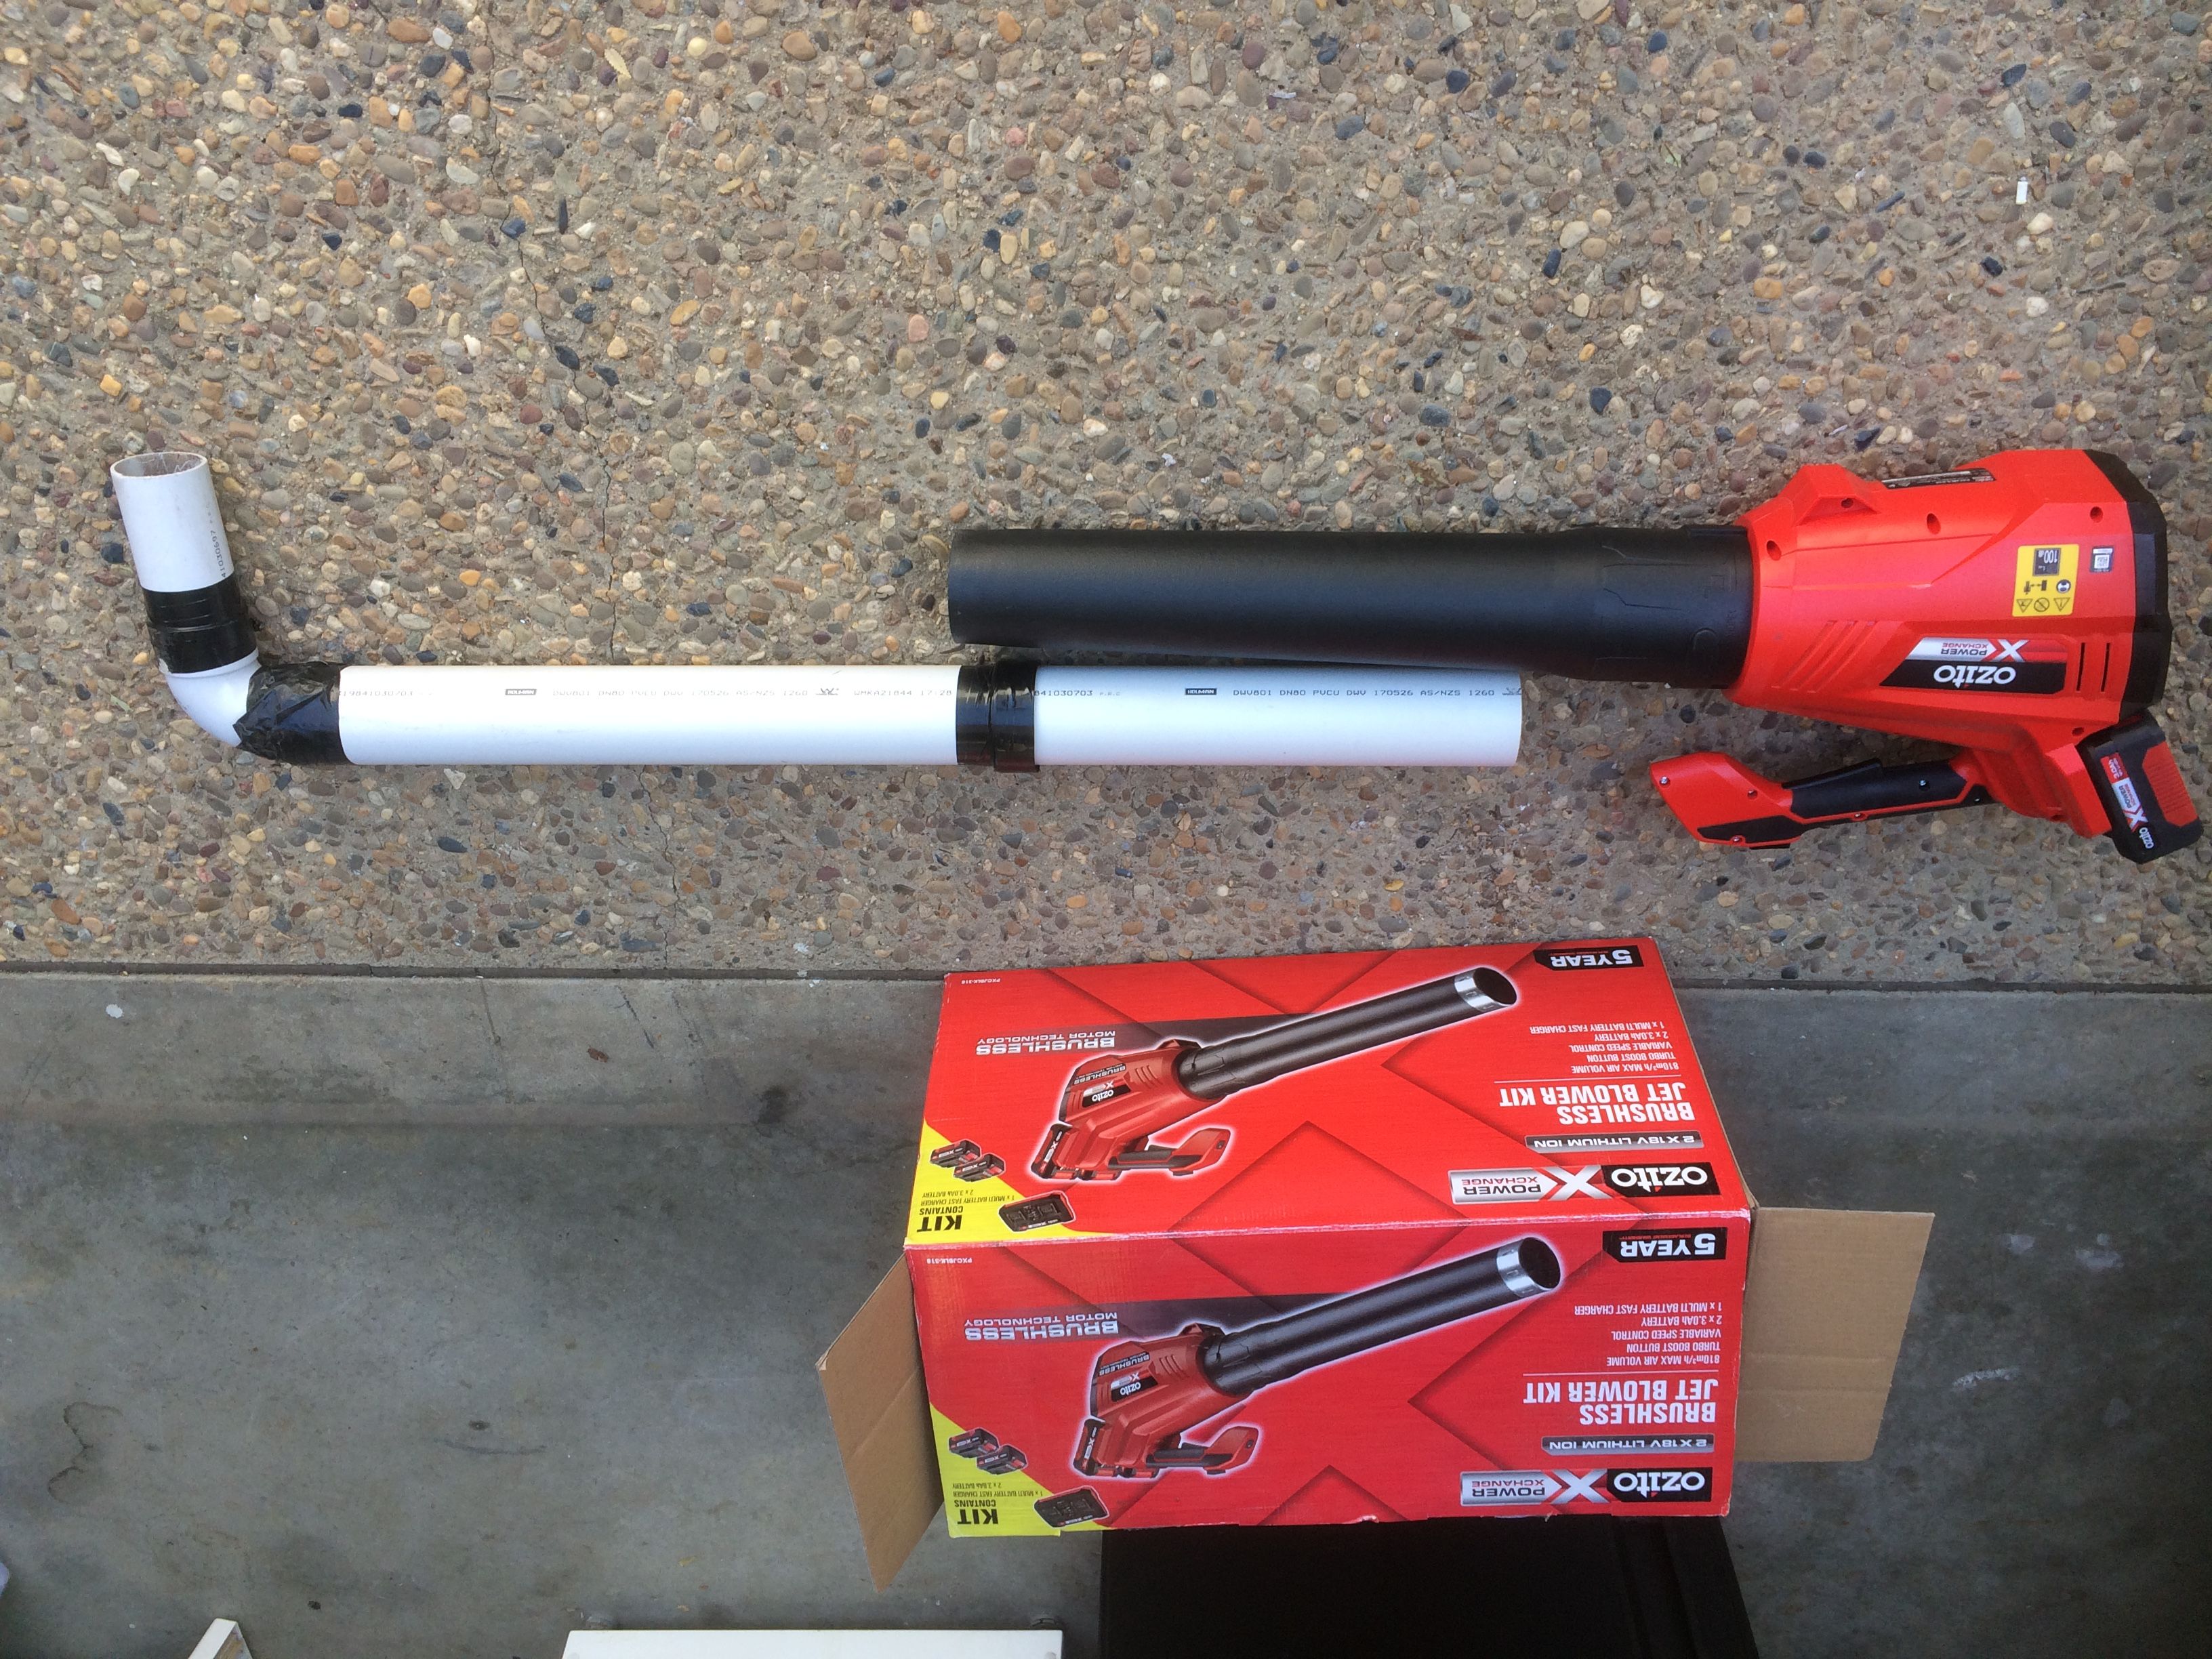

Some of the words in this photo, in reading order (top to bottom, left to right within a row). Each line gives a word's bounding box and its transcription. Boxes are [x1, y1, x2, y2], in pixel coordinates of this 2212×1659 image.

[2043, 550, 2058, 564] 100
[2118, 785, 2132, 808] POWER
[1550, 954, 1613, 967] YEAR
[1612, 949, 1633, 964] 5
[1530, 1025, 1565, 1034] CHARGER
[1568, 1024, 1589, 1033] FAST
[1590, 1023, 1624, 1032] BATTERY
[977, 1033, 1064, 1044] TECHNOLOGY
[1069, 1031, 1115, 1039] MOTOR
[1595, 1033, 1629, 1042] BATTERY
[1631, 1031, 1654, 1040] 3.0Ah
[1663, 1031, 1668, 1039] 2
[976, 1037, 1115, 1056] BRUSHLESS
[1569, 1044, 1605, 1052] CONTROL
[1607, 1042, 1631, 1051] SPEED
[1632, 1041, 1673, 1050] VARIABLE
[1586, 1054, 1619, 1063] BUTTON
[1621, 1052, 1647, 1061] BOOST
[1649, 1051, 1676, 1060] TURBO
[1571, 1065, 1605, 1073] VOLUME
[1607, 1064, 1620, 1072] AIR
[1622, 1063, 1643, 1071] MAX
[1499, 1087, 1536, 1107] KIT
[1540, 1084, 1640, 1105] BLOWER
[1647, 1082, 1686, 1102] JET
[1557, 1102, 1696, 1125] BRUSHLESS
[1534, 1140, 1562, 1148] ION
[1568, 1137, 1629, 1147] LITHIUM
[1462, 1176, 1538, 1185] XCHANGE
[1463, 1184, 1542, 1195] POWER
[920, 1206, 963, 1215] CONTAINS
[916, 1215, 962, 1232] KIT
[1620, 1239, 1692, 1257] YEAR
[1694, 1233, 1716, 1255] 5
[1574, 1305, 1614, 1315] CHARGER
[1616, 1305, 1638, 1315] FAST
[1640, 1303, 1679, 1313] BATTERY
[1681, 1303, 1707, 1312] MULTI
[1718, 1302, 1722, 1311] 1
[964, 1315, 1061, 1326] TECHNOLOGY
[1065, 1312, 1117, 1321] MOTOR
[1641, 1316, 1679, 1327] BATTERY
[1682, 1315, 1706, 1325] 3.0Ah
[1716, 1315, 1722, 1325] 2
[964, 1320, 1118, 1340] BRUSHLESS
[1611, 1330, 1649, 1340] CONTROL
[1652, 1330, 1677, 1339] SPEED
[1680, 1328, 1721, 1338] VARIABLE
[1627, 1343, 1660, 1353] BUTTON
[1662, 1343, 1689, 1352] BOOST
[1693, 1341, 1721, 1351] TURBO
[1607, 1356, 1641, 1366] VOLUME
[1644, 1356, 1658, 1366] AIR
[1661, 1355, 1681, 1365] MAX
[1523, 1382, 1561, 1404] KIT
[1568, 1380, 1667, 1402] BLOWER
[1675, 1379, 1719, 1400] JET
[1580, 1402, 1716, 1425] BRUSHLESS
[1549, 1441, 1577, 1450] ION
[1582, 1440, 1645, 1449] LITHIUM
[1696, 1439, 1707, 1448] 2
[1472, 1479, 1544, 1488] XCHANGE
[1472, 1488, 1545, 1497] POWER
[954, 1499, 996, 1507] CONTAINS
[957, 1509, 999, 1524] KIT
